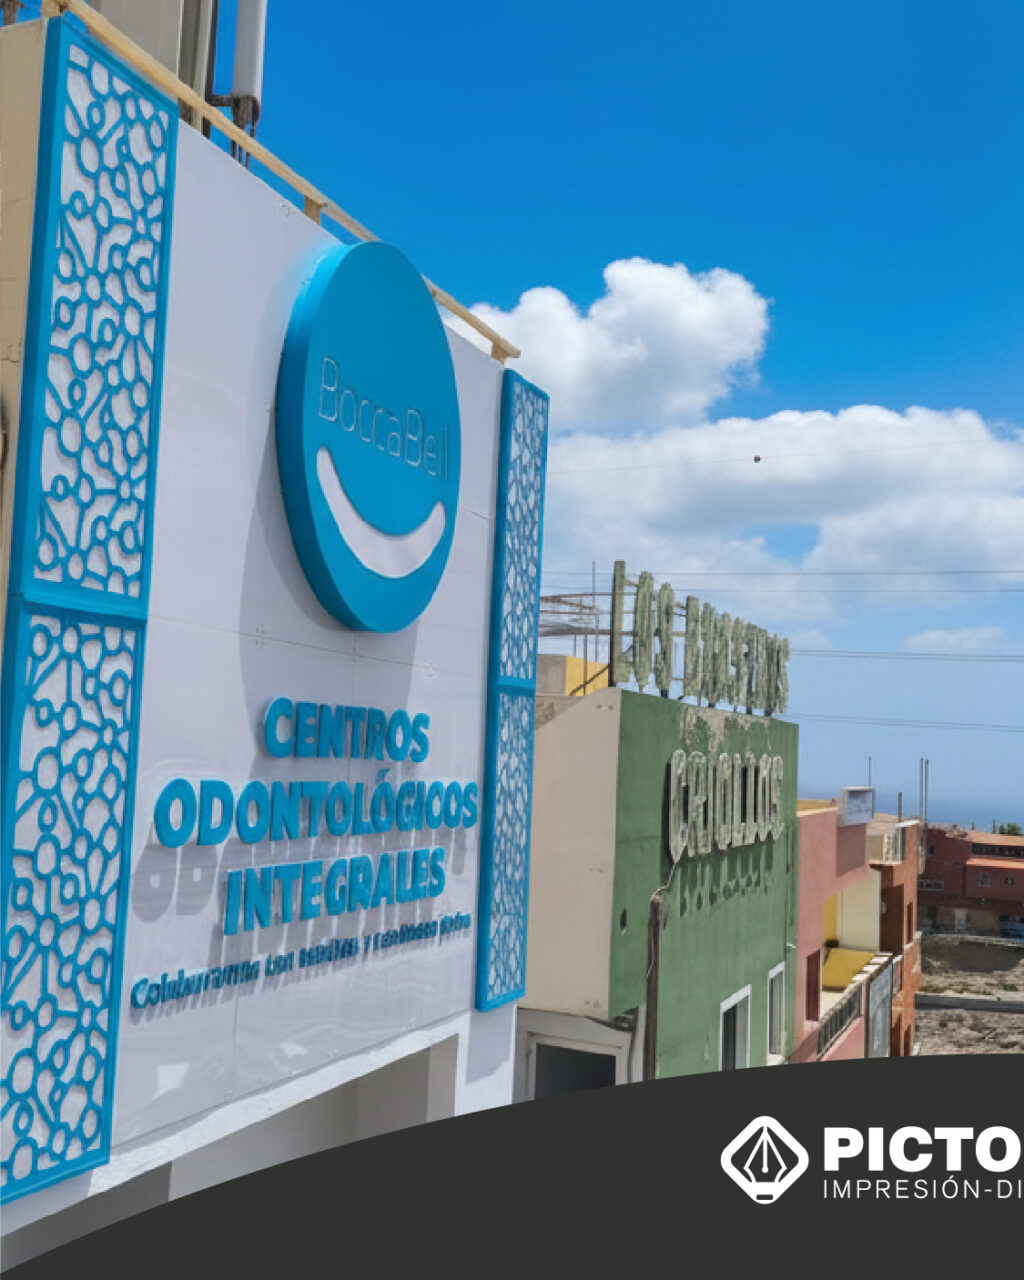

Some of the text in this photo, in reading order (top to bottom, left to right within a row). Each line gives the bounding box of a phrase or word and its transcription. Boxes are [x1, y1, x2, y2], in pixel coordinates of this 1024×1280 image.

[319, 356, 448, 480] BoccaBell
[264, 697, 431, 763] CENTROS
[153, 768, 478, 849] ODONTOLÓGICOS
[224, 847, 446, 936] INTEGRALES
